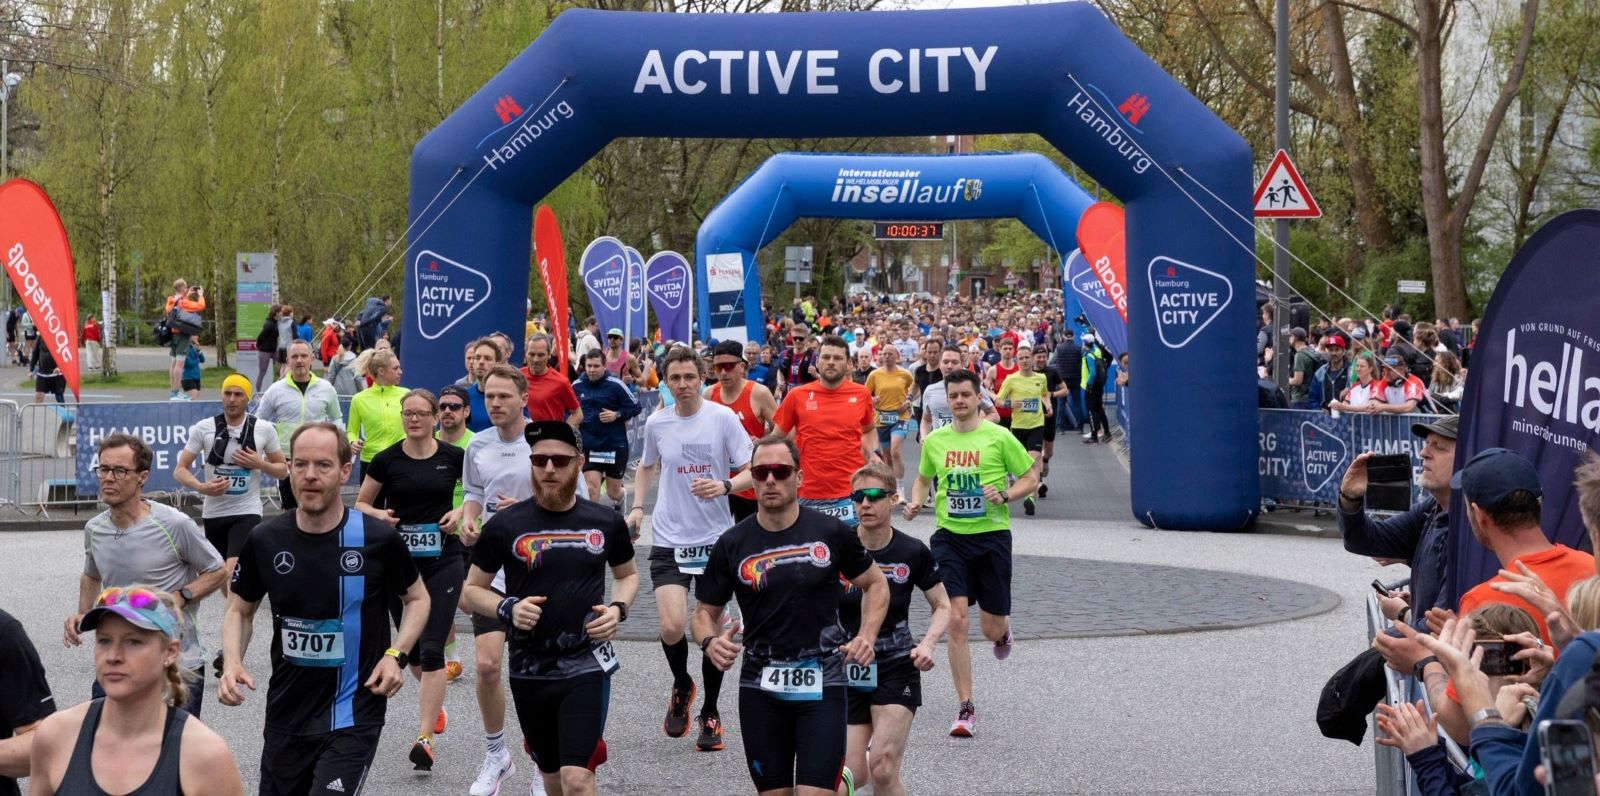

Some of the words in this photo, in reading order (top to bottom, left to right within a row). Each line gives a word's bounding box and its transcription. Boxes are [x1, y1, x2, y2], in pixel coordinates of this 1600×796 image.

[633, 49, 839, 95] ACTIVE
[868, 45, 998, 94] CITY
[483, 100, 575, 170] Hamburg
[1067, 92, 1152, 174] Hamburg
[838, 168, 921, 178] Internationaler
[831, 178, 965, 204] insellauf
[886, 225, 937, 237] 10:00:37
[420, 272, 449, 283] Hamburg
[1155, 280, 1190, 288] Hamburg
[421, 286, 475, 302] ACTIVE
[1160, 293, 1218, 308] ACTIVE
[422, 303, 455, 317] CITY
[1162, 310, 1199, 325] CITY
[1520, 322, 1536, 333] VON
[1538, 322, 1565, 334] GRUND
[1567, 328, 1581, 340] AUF
[89, 425, 197, 447] HAMBUR
[945, 450, 980, 468] RUN
[1306, 450, 1338, 463] ACTIVE
[677, 463, 712, 475] #LÄUFT
[1259, 456, 1292, 477] CITY
[1306, 463, 1329, 475] CITY
[946, 473, 980, 491] FUN
[950, 497, 982, 510] 3912
[402, 533, 437, 547] 2643
[287, 631, 336, 653] 3707
[768, 668, 816, 687] 4186
[849, 665, 871, 681] 02
